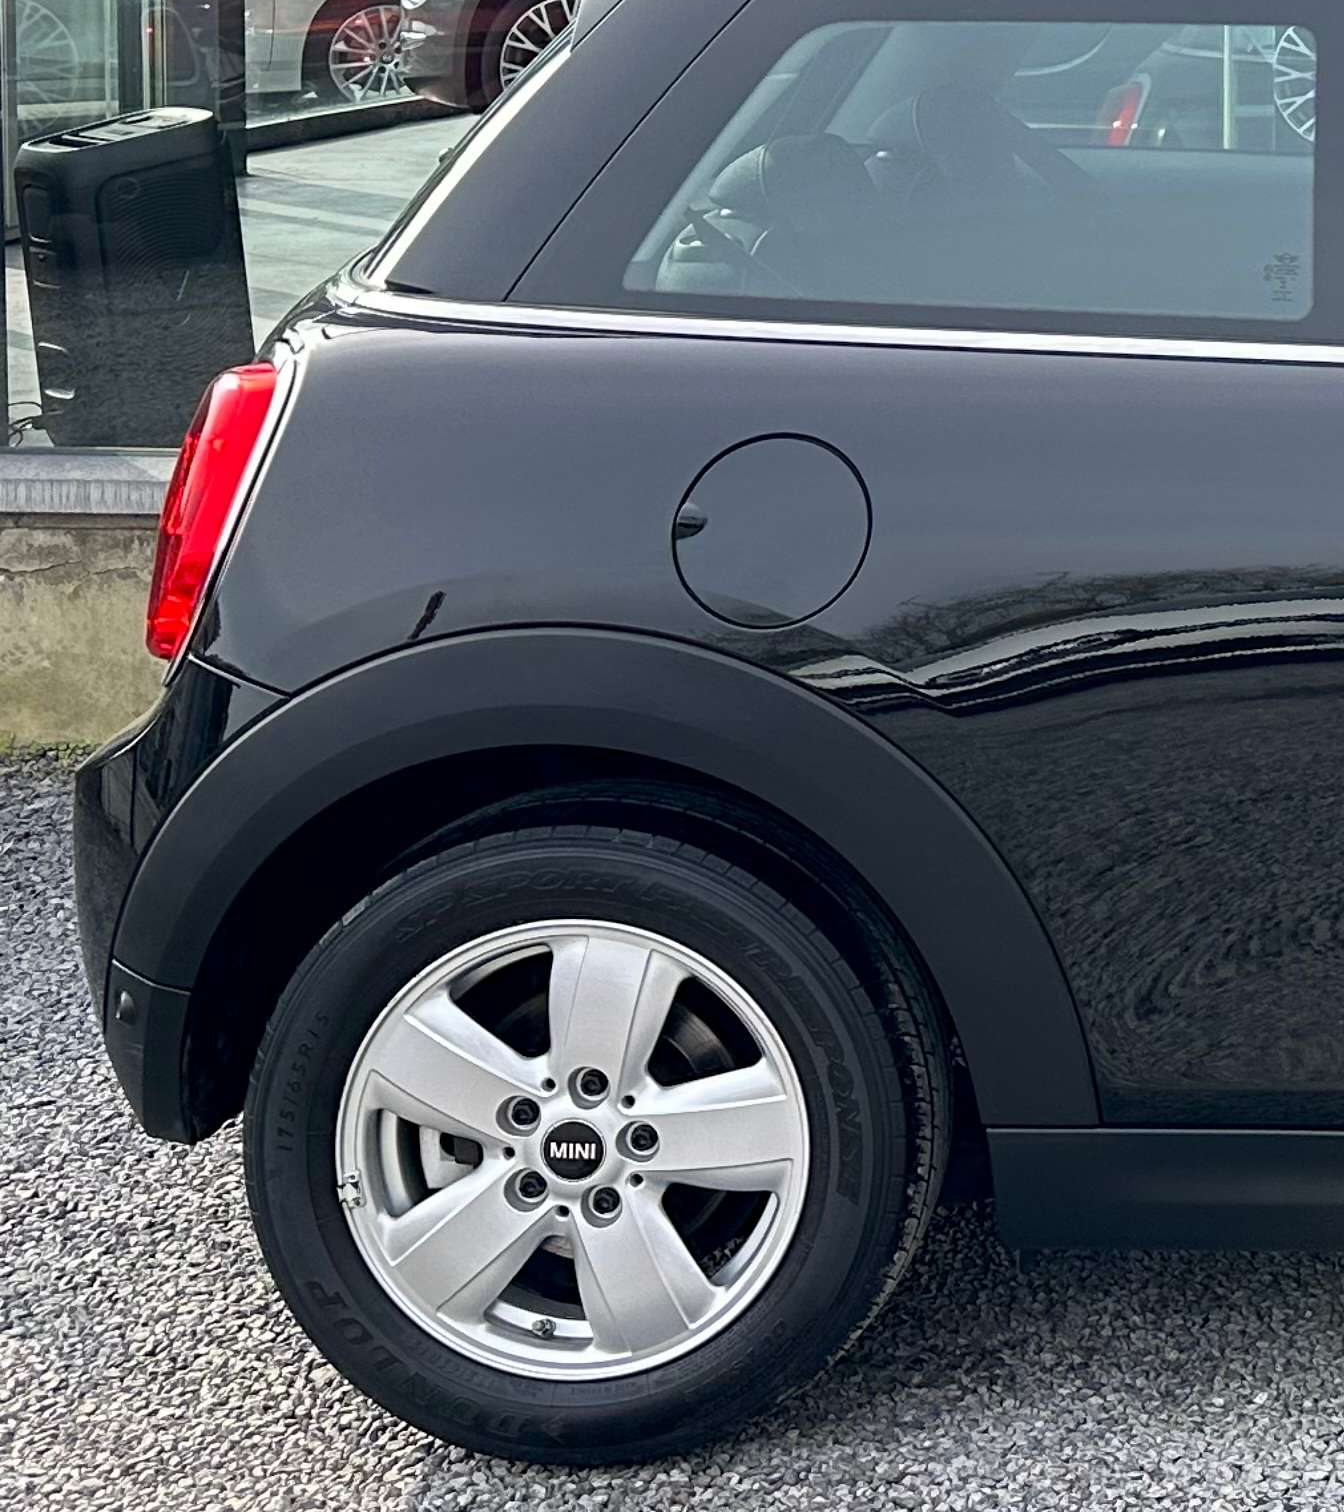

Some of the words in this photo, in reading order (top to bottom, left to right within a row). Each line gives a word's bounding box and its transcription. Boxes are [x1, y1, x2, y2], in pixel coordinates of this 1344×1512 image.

[275, 1012, 331, 1151] 175/65R15
[549, 1141, 597, 1160] MINI
[303, 1278, 523, 1442] DUNLOP
